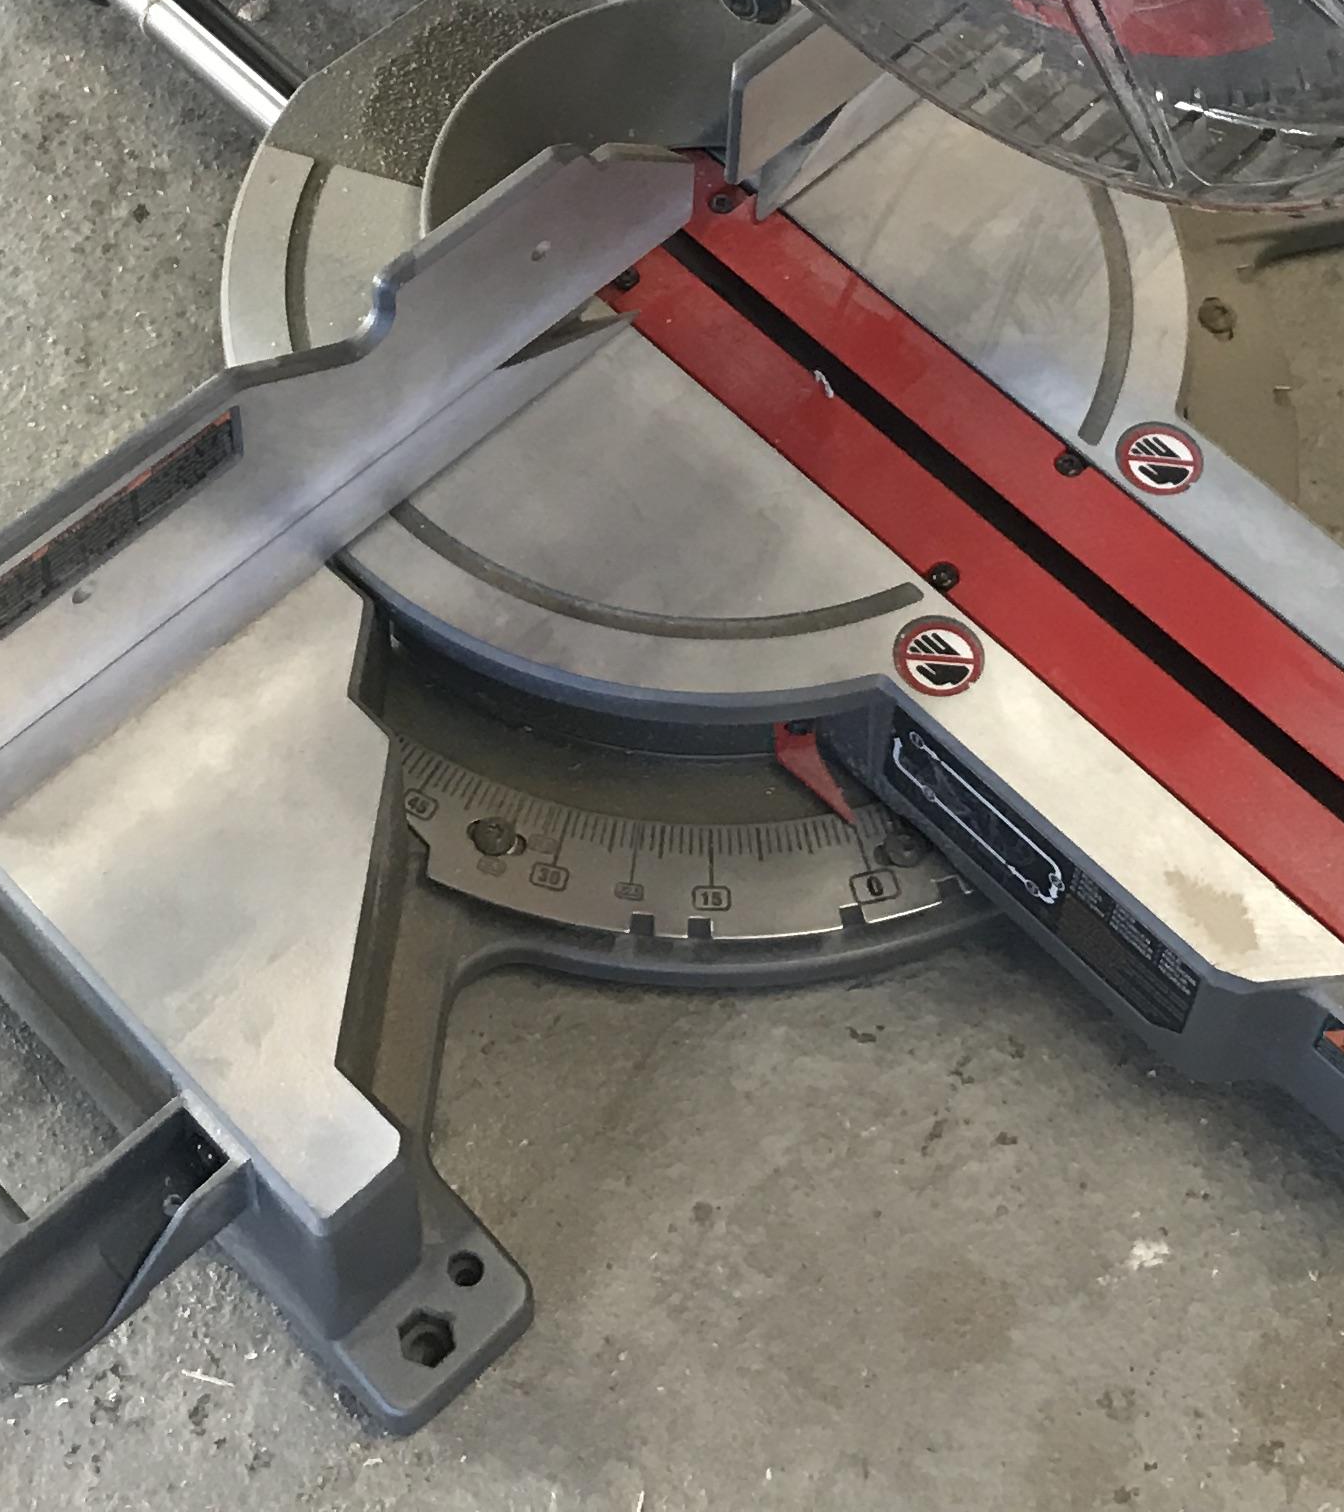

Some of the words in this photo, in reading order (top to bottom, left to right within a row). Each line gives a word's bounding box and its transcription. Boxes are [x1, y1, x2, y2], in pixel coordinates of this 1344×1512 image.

[407, 795, 432, 815] 45
[537, 867, 562, 886] 30
[866, 875, 884, 897] 0
[701, 891, 724, 907] 15
